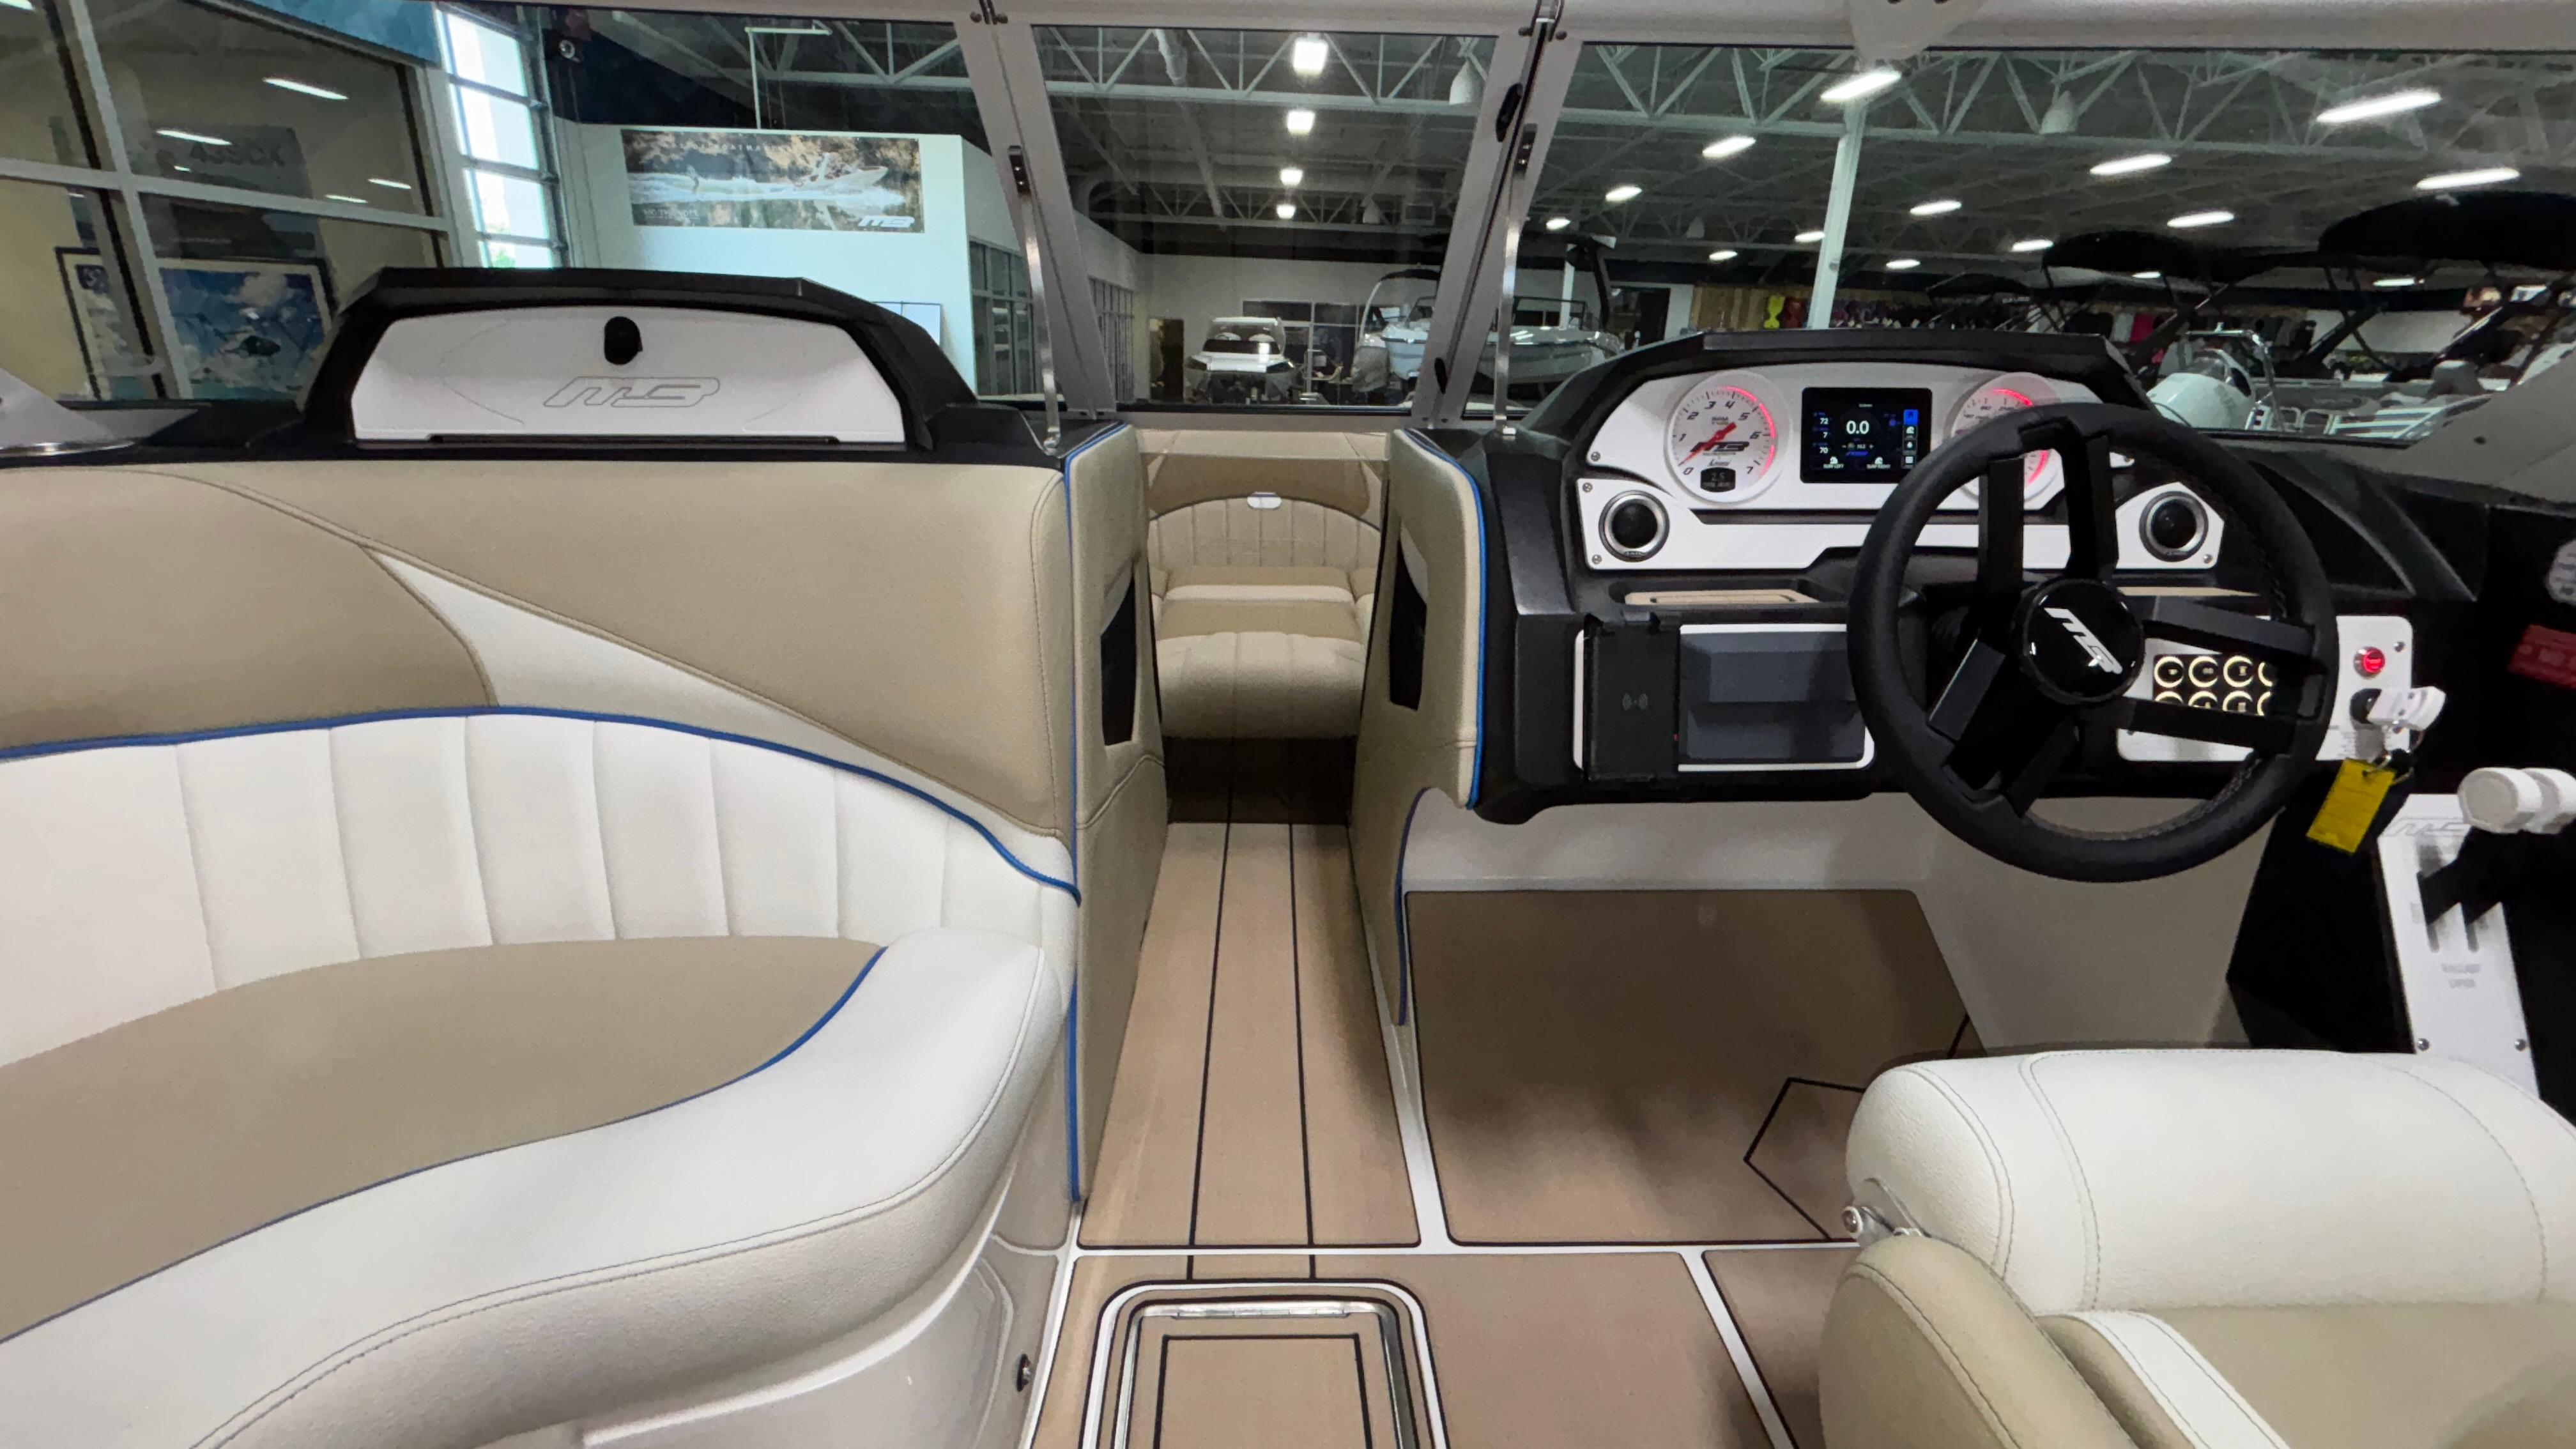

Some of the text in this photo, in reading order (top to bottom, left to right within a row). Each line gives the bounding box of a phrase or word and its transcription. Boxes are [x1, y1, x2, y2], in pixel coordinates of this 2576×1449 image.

[1705, 401, 1717, 410] 3
[1724, 401, 1735, 409] 4
[1687, 411, 1699, 420] 2
[1738, 412, 1751, 421] 5
[1820, 417, 1829, 425] 72
[1846, 420, 1871, 435] 0.0
[1678, 433, 1687, 442] 1
[1749, 431, 1762, 440] 6
[1682, 466, 1694, 475] 0
[1746, 466, 1754, 475] 7
